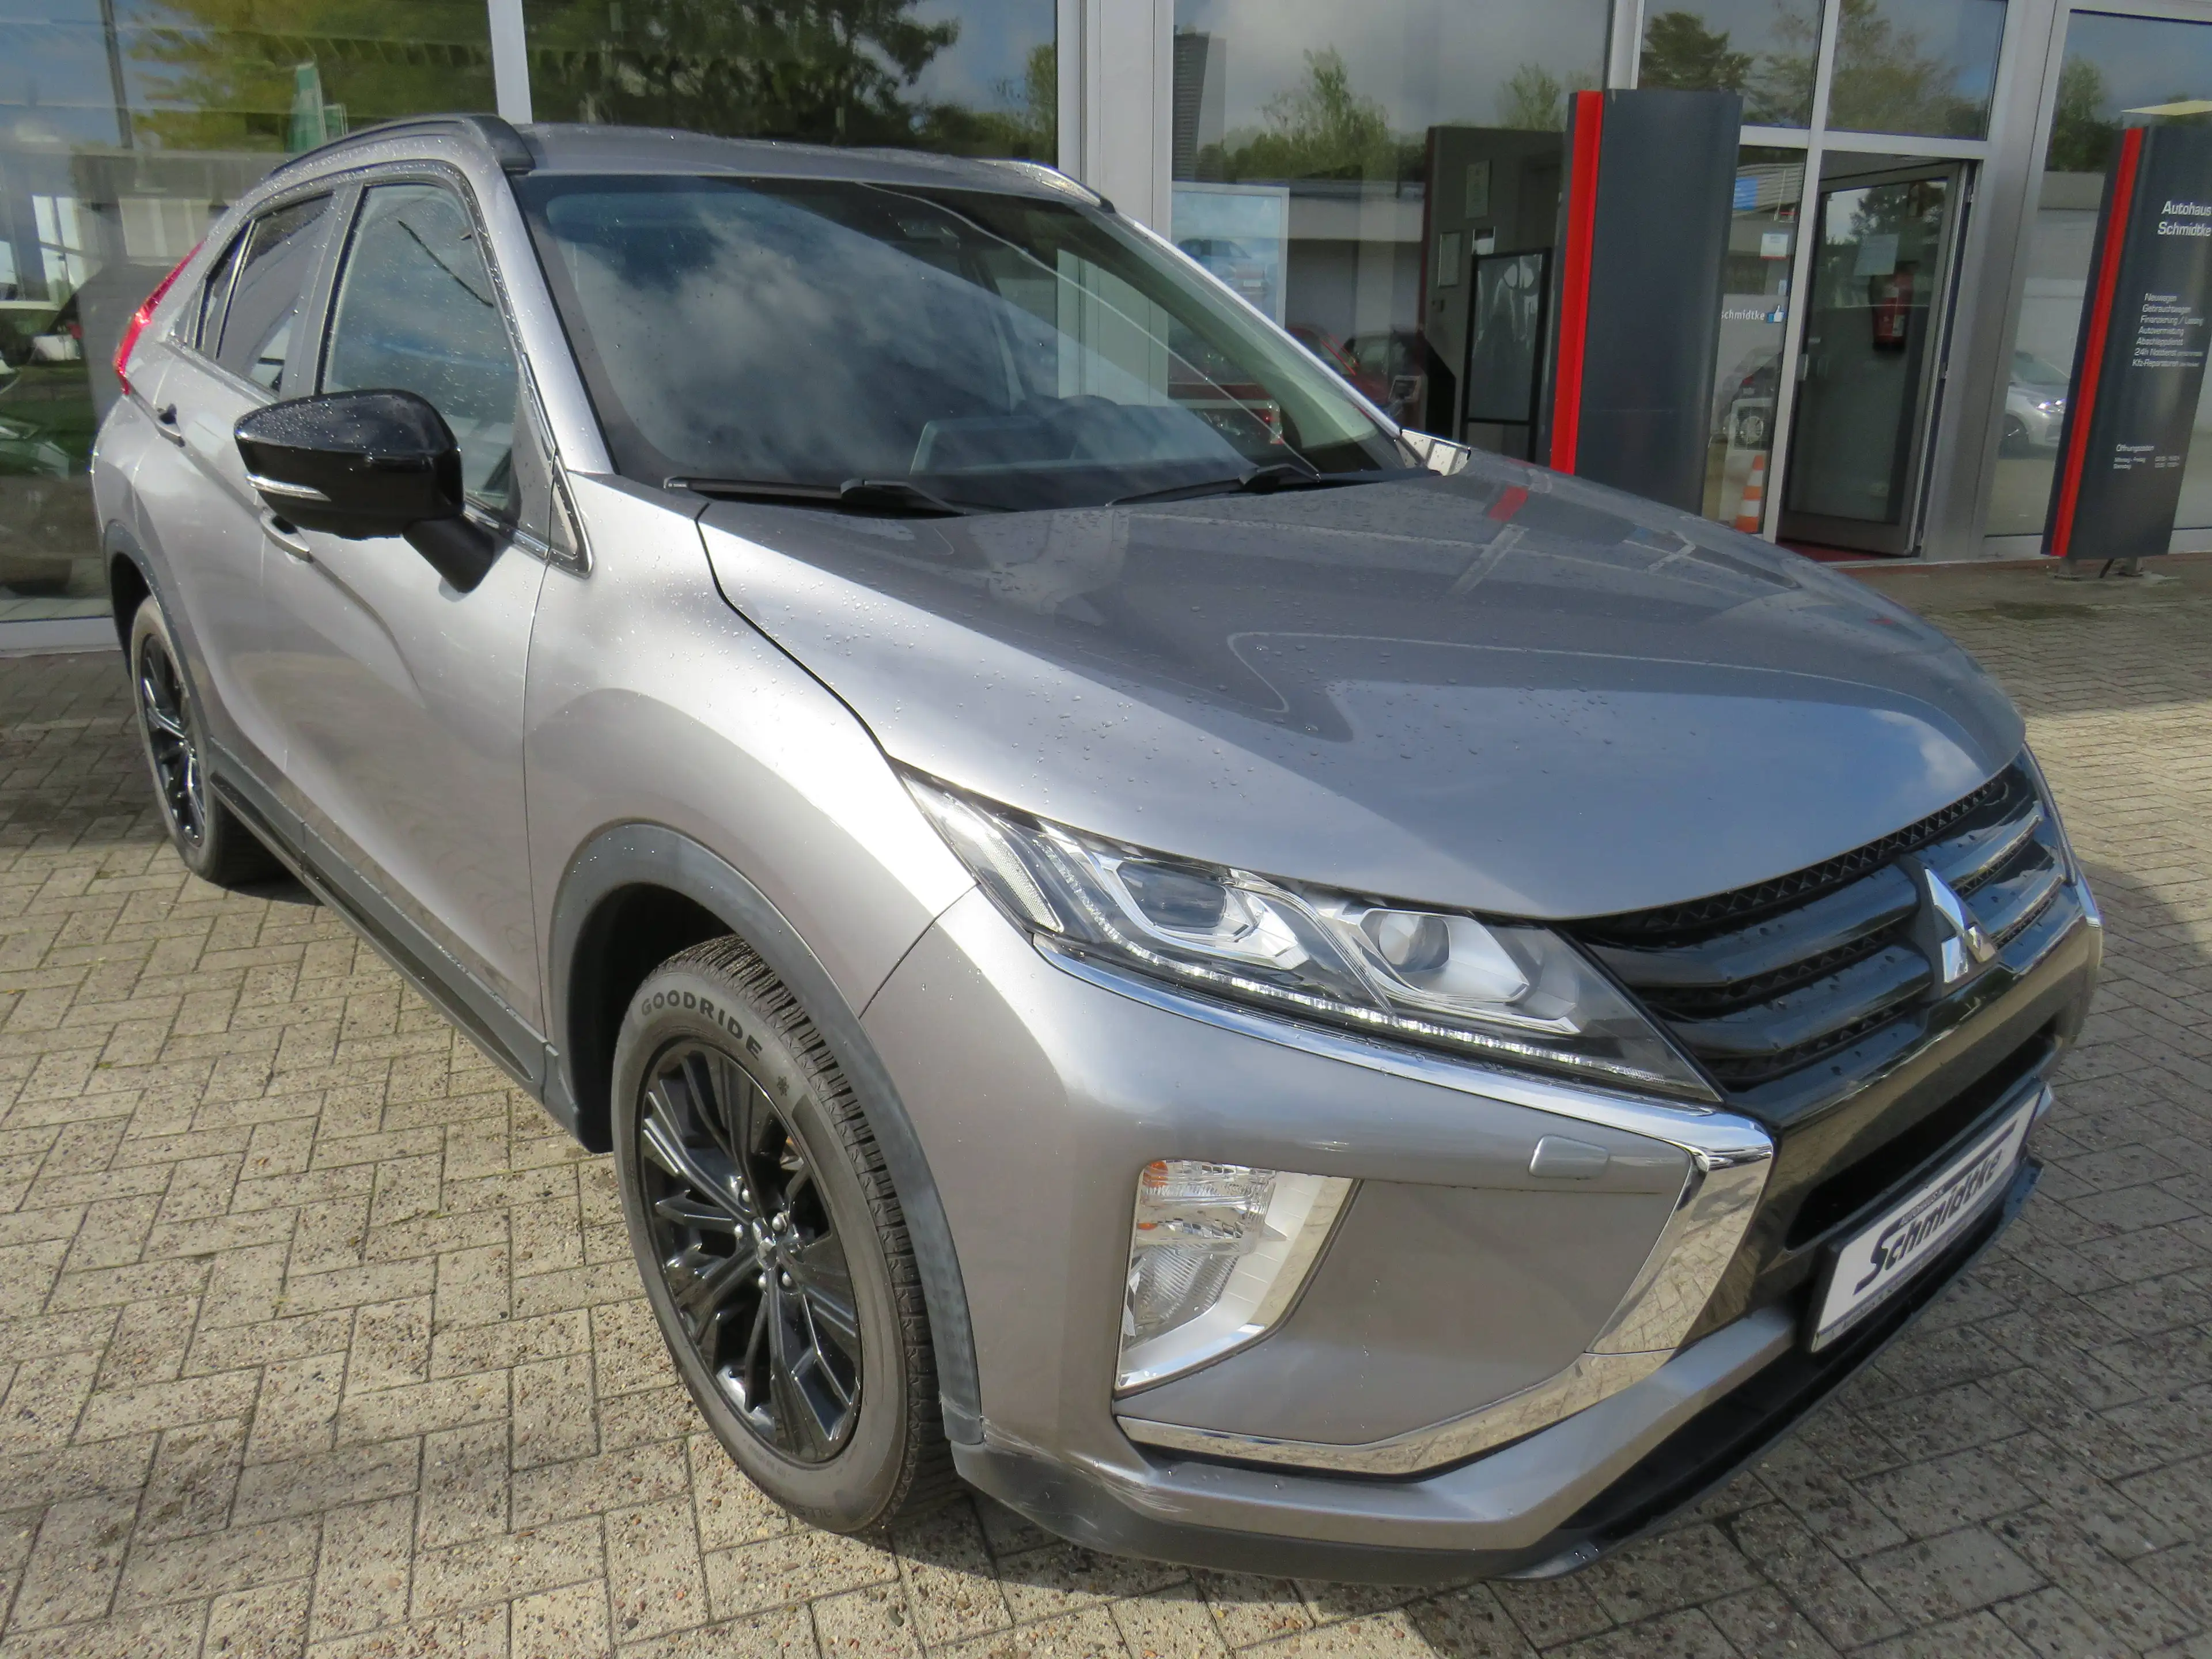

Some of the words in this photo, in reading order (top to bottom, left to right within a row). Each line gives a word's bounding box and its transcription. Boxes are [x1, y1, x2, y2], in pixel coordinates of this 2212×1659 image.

[2161, 200, 2212, 216] Autohaus
[2157, 221, 2212, 237] Schmidtke
[2134, 347, 2149, 356] 24h
[641, 989, 763, 1061] GOODRIDE
